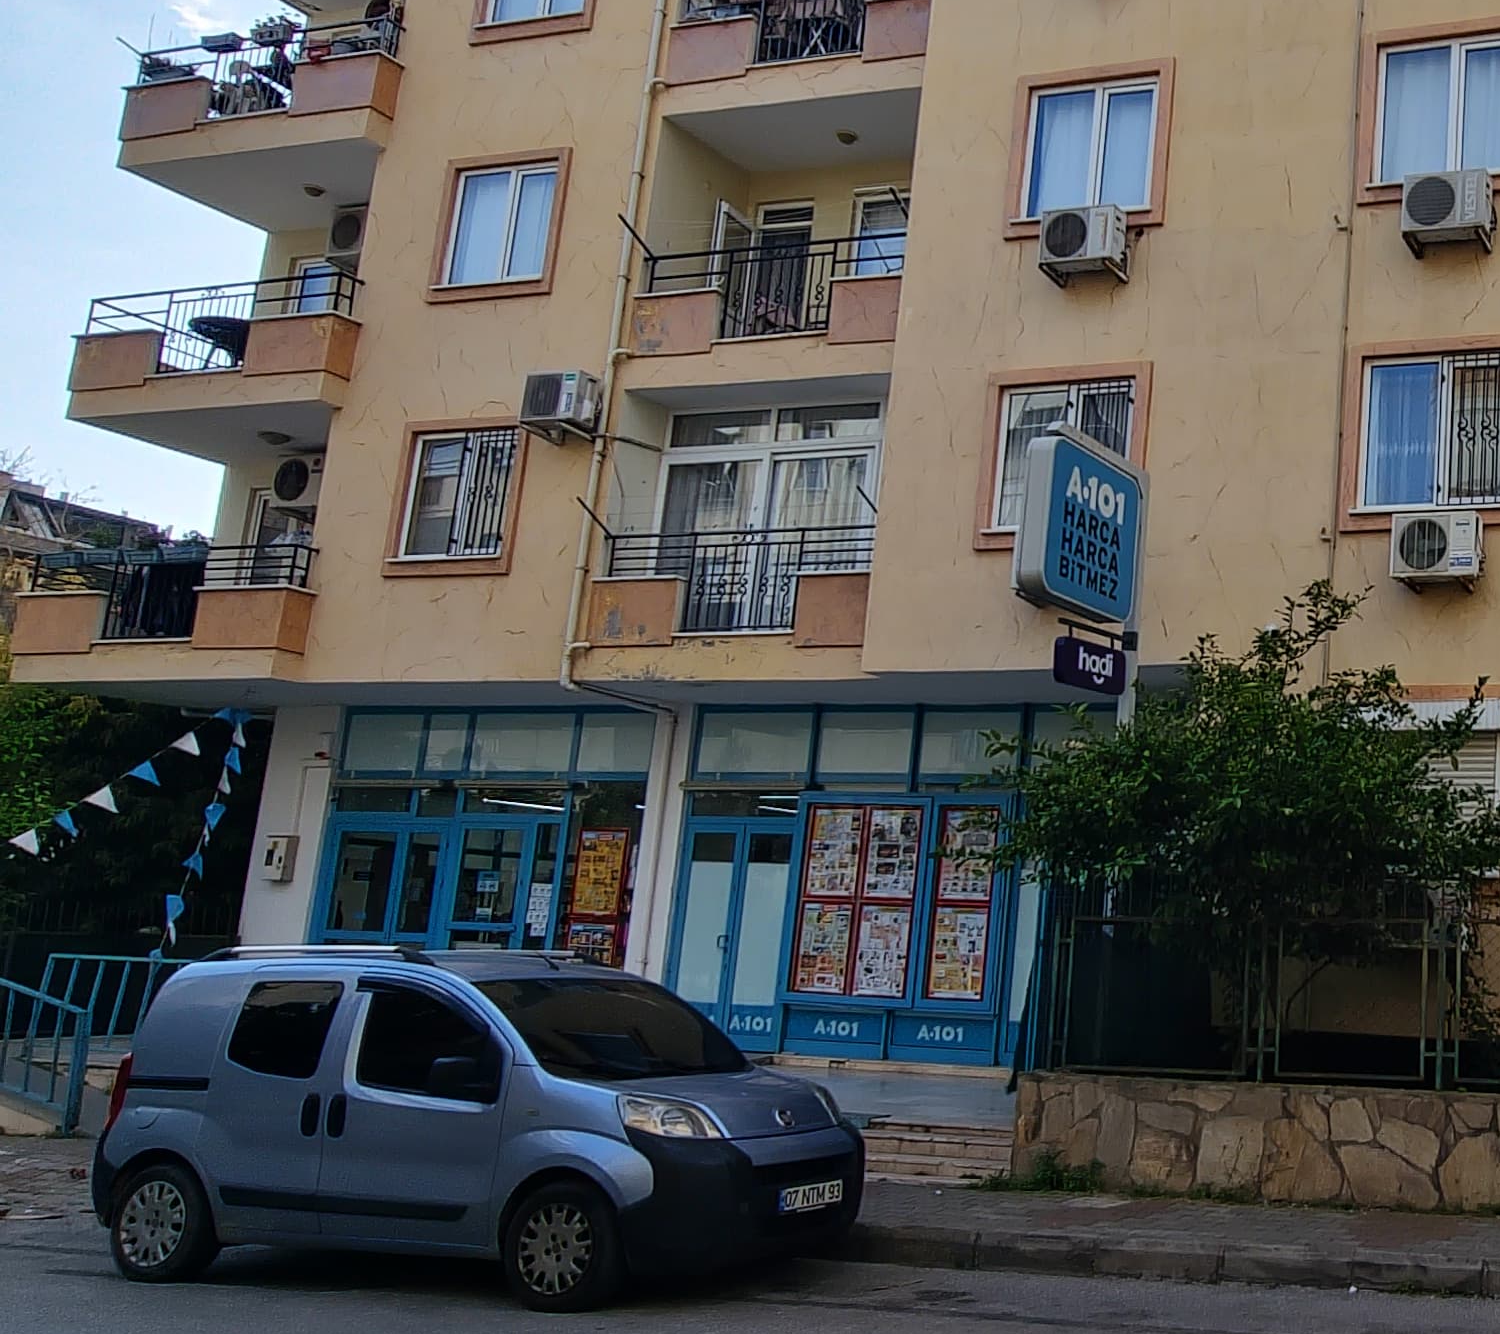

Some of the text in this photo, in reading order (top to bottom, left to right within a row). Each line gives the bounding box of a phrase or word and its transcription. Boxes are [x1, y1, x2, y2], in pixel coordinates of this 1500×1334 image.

[1063, 501, 1120, 551] HARCA
[1061, 526, 1119, 577] HARCA
[1078, 646, 1114, 678] hadi
[785, 1182, 841, 1207] 07 NTM 93
